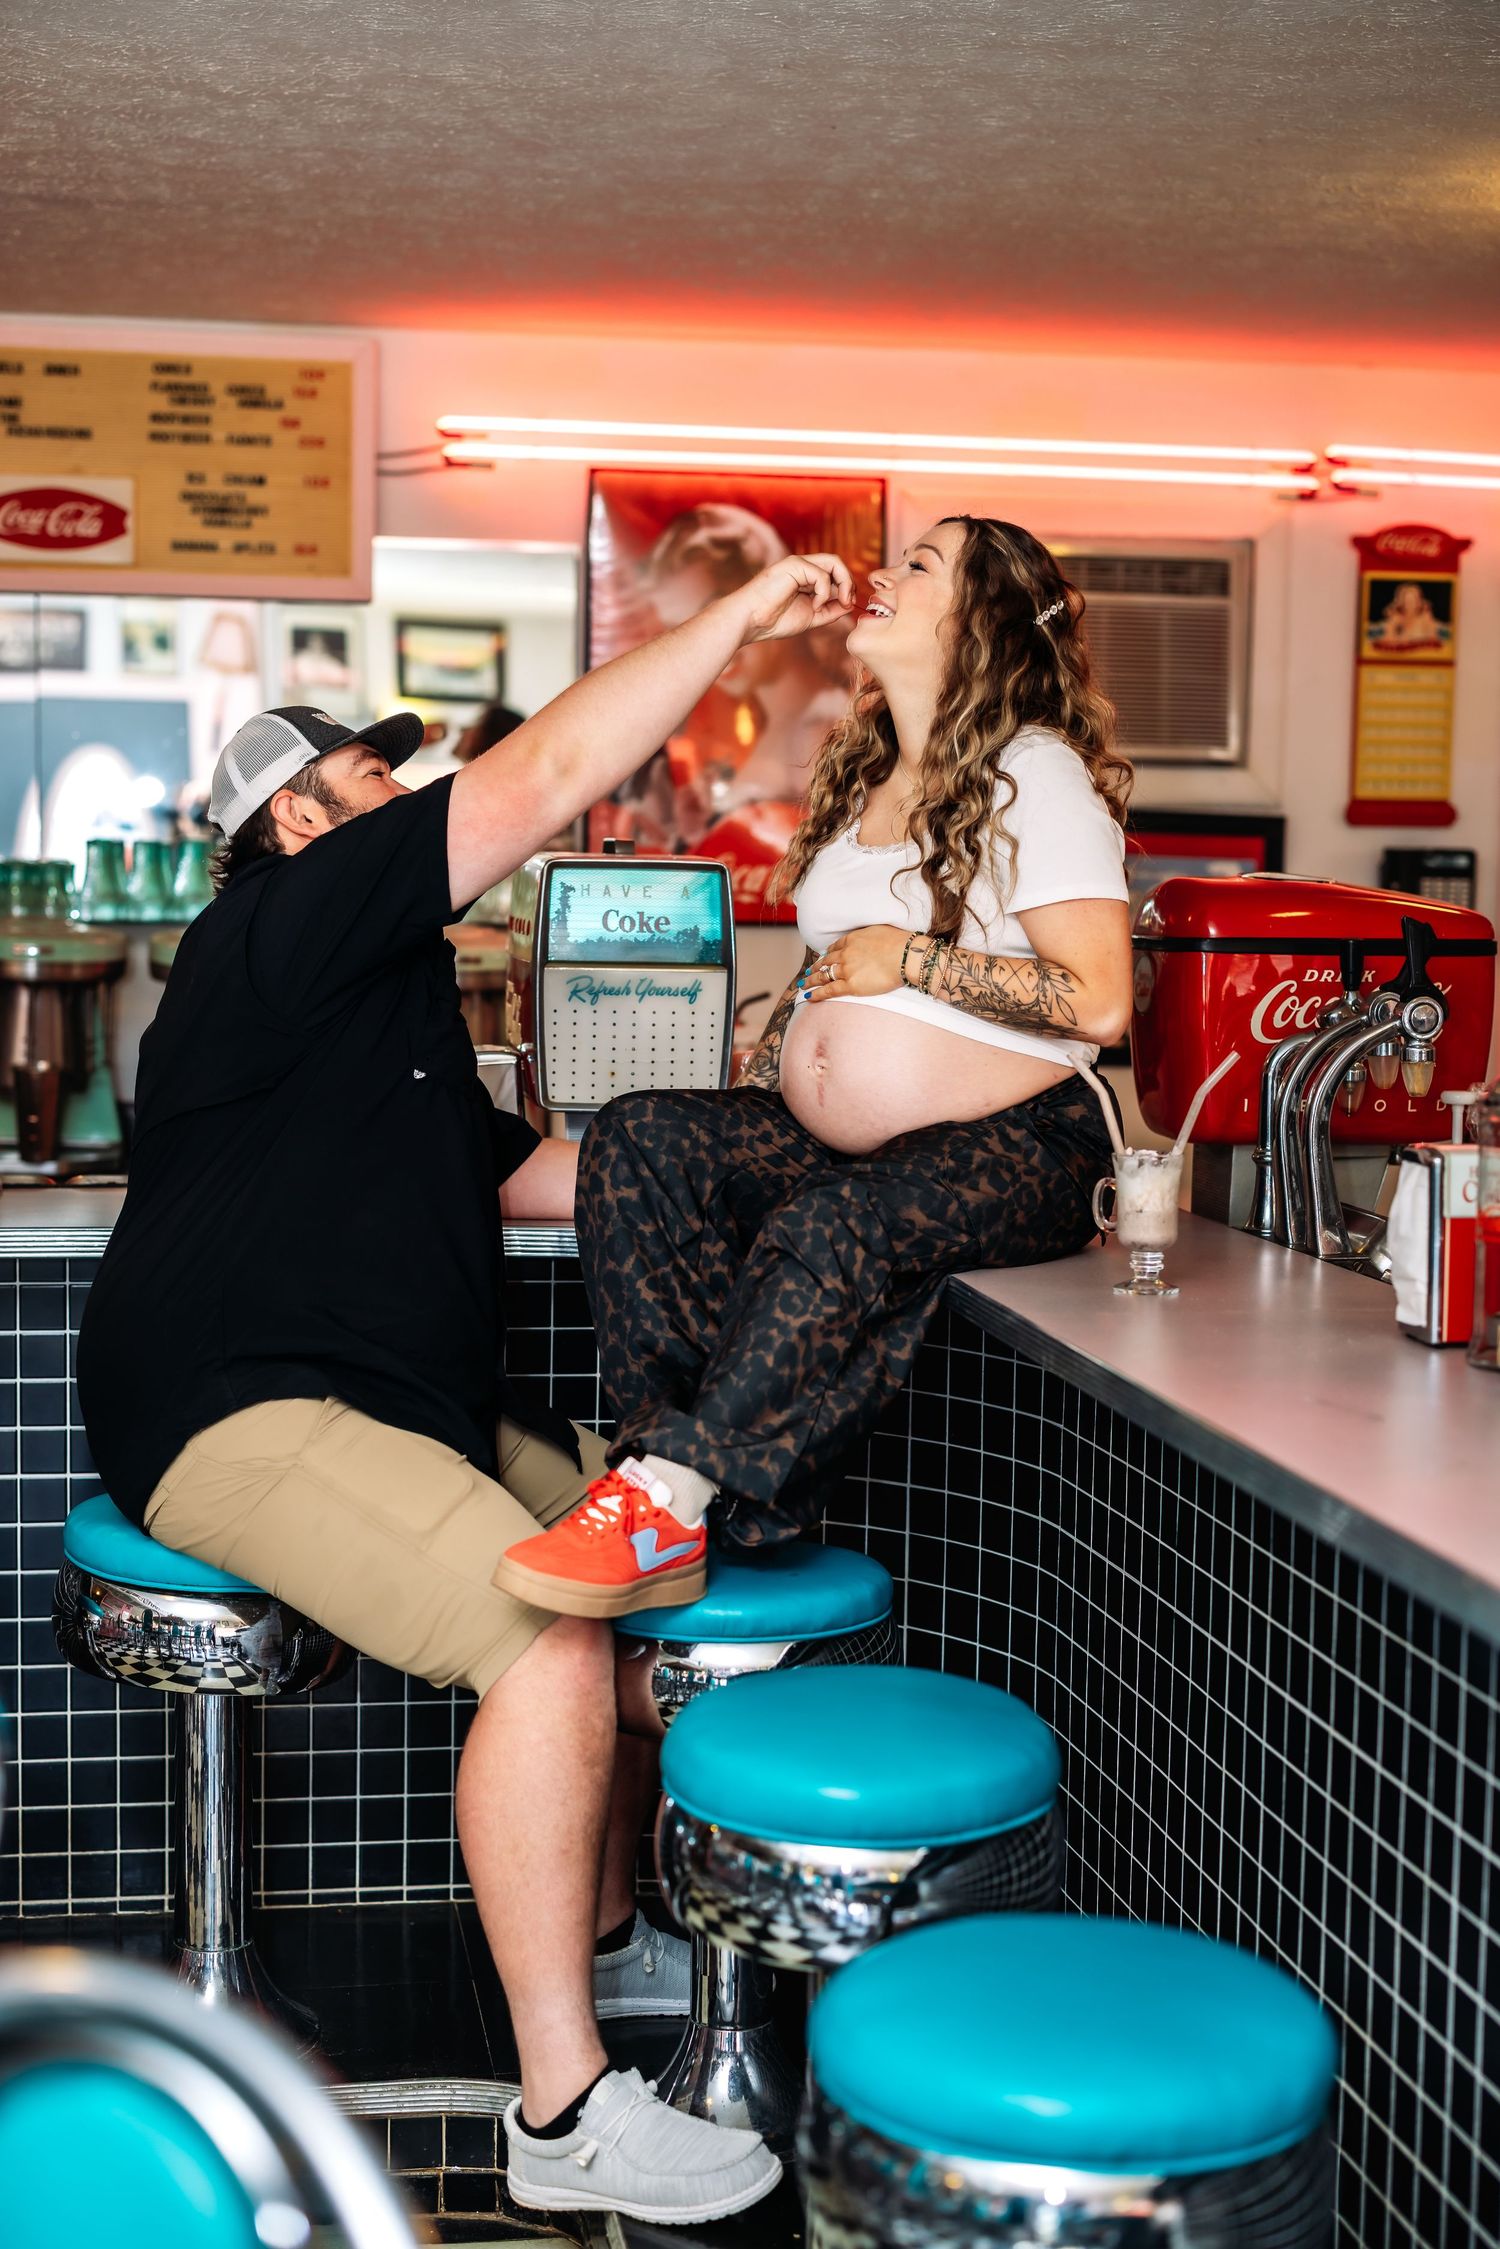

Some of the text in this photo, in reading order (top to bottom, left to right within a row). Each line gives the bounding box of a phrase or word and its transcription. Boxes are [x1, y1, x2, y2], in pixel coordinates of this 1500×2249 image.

[580, 884, 691, 899] HAVE A
[601, 908, 671, 934] Coke
[566, 975, 703, 1006] Refresh Yourself
[1374, 1099, 1447, 1112] OLD
